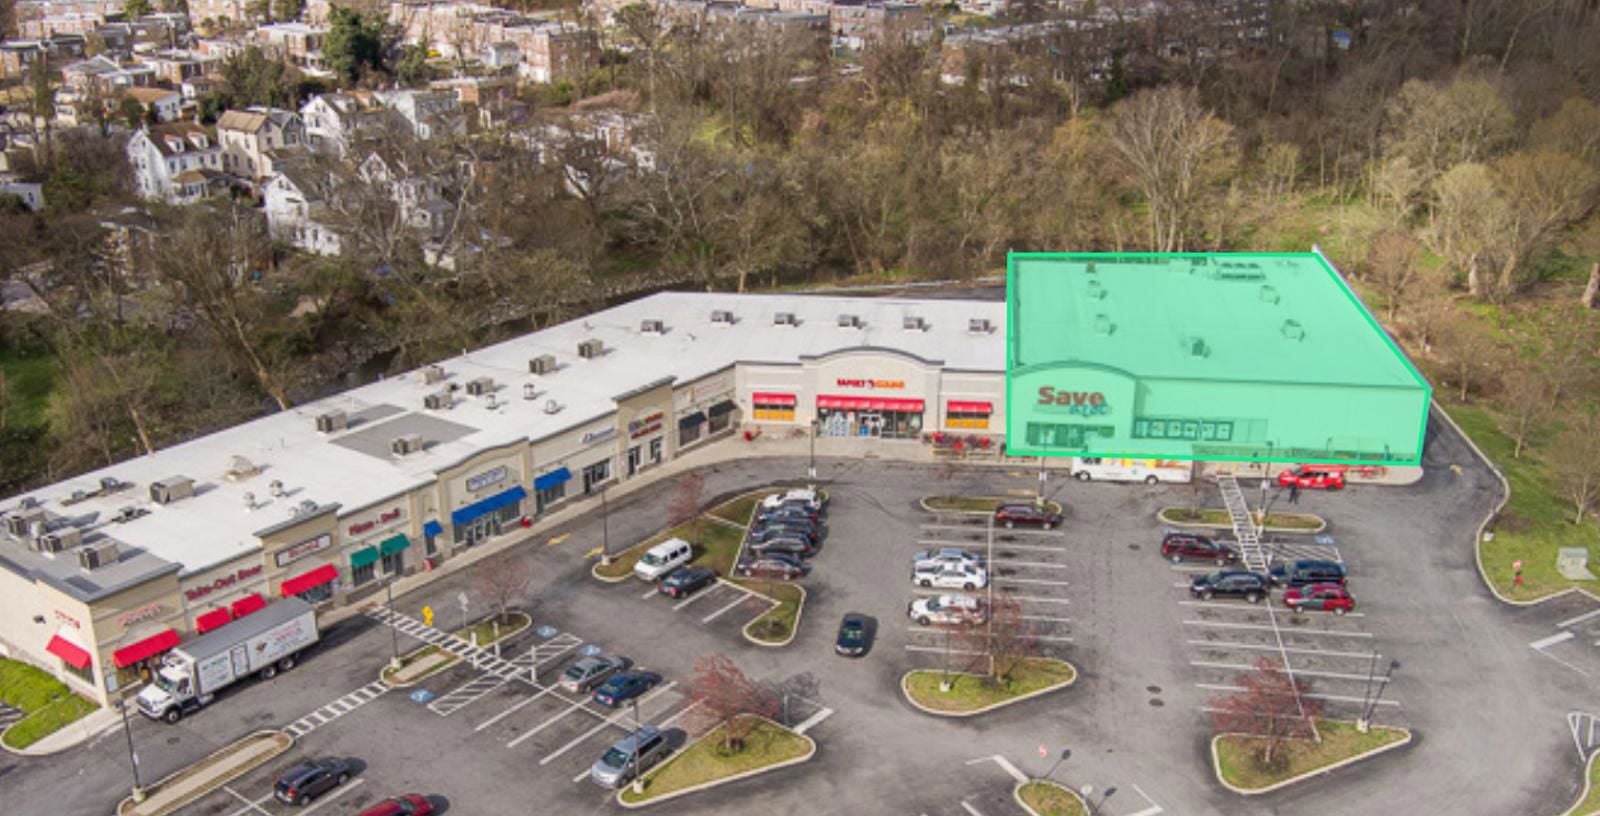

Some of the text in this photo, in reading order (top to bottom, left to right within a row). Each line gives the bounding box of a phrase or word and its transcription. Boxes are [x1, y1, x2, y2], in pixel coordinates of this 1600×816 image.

[1038, 386, 1104, 407] Save
[184, 564, 263, 602] Take-Out Beer
